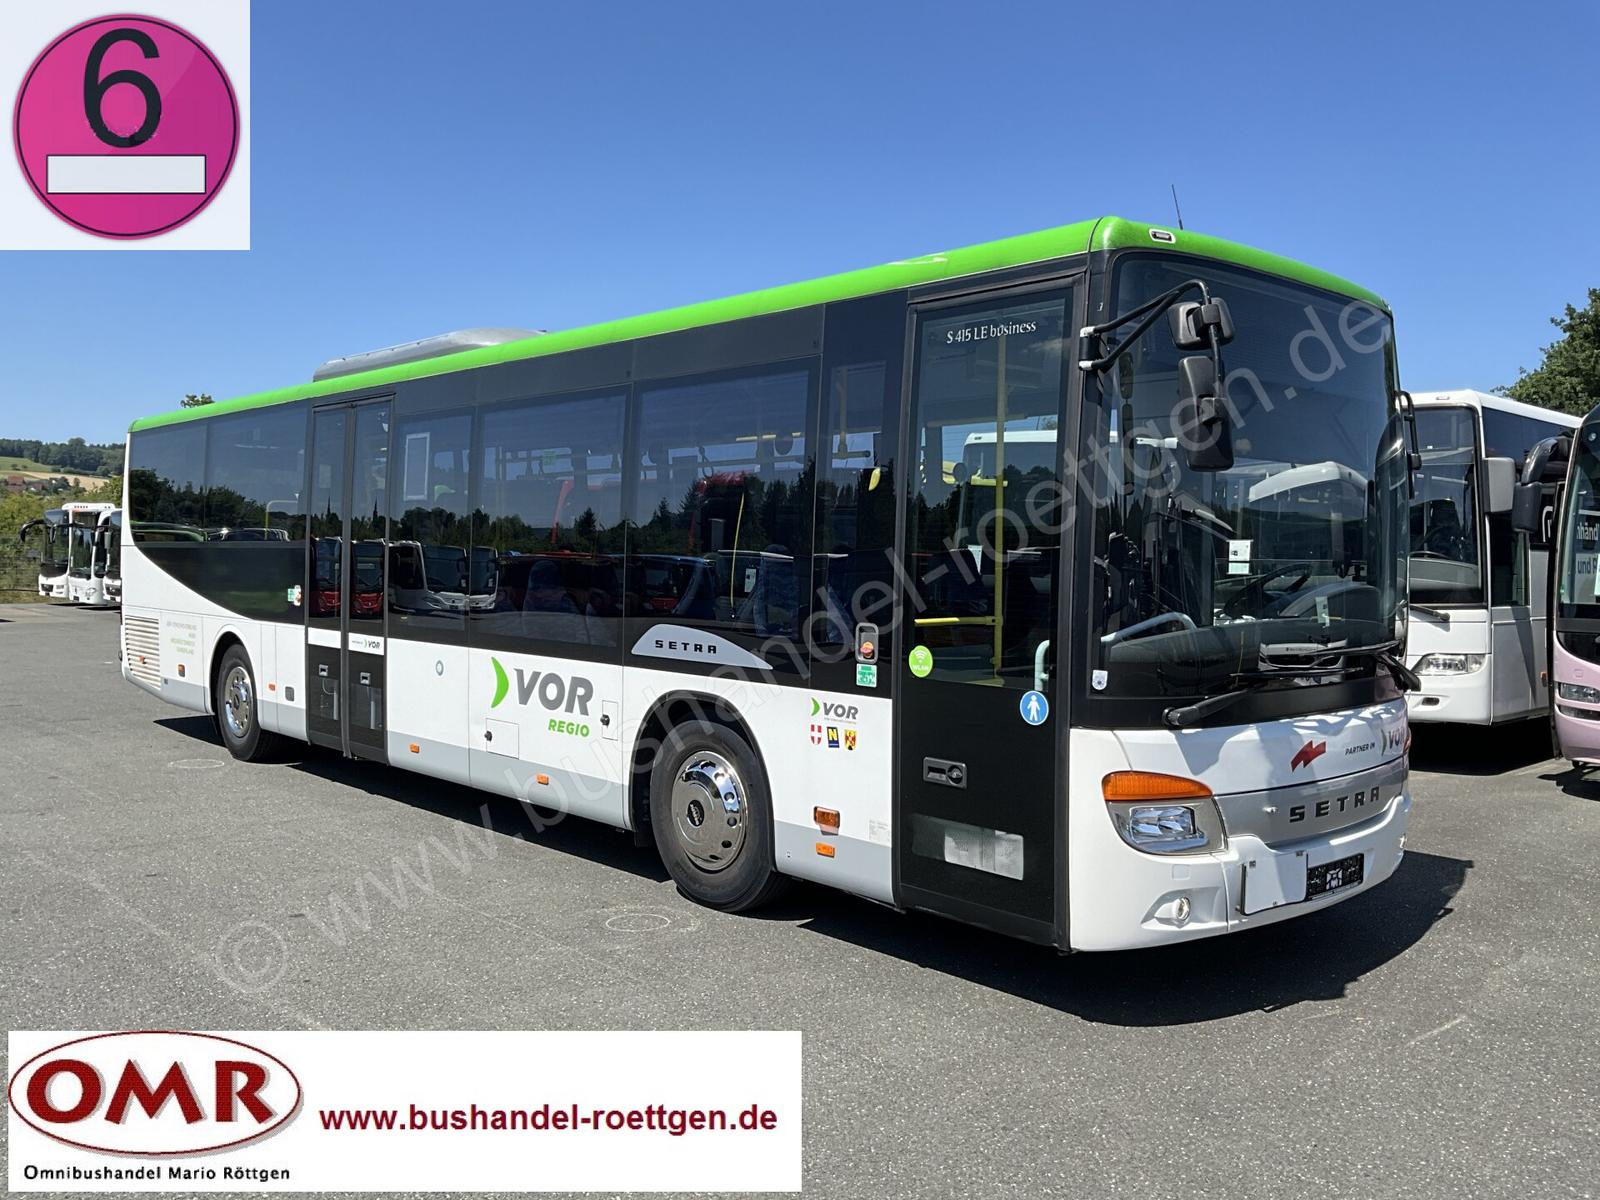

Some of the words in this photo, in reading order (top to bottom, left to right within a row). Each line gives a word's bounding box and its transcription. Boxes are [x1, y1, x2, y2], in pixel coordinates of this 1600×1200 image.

[946, 330, 954, 344] S
[955, 327, 972, 343] 415
[974, 325, 988, 340] LE
[990, 321, 1036, 337] business
[654, 639, 718, 654] SETRA
[513, 667, 594, 717] VOR
[823, 702, 858, 719] VOR
[547, 718, 591, 739] REGIO
[1344, 742, 1370, 756] PARTNER
[1289, 786, 1380, 823] SETRA
